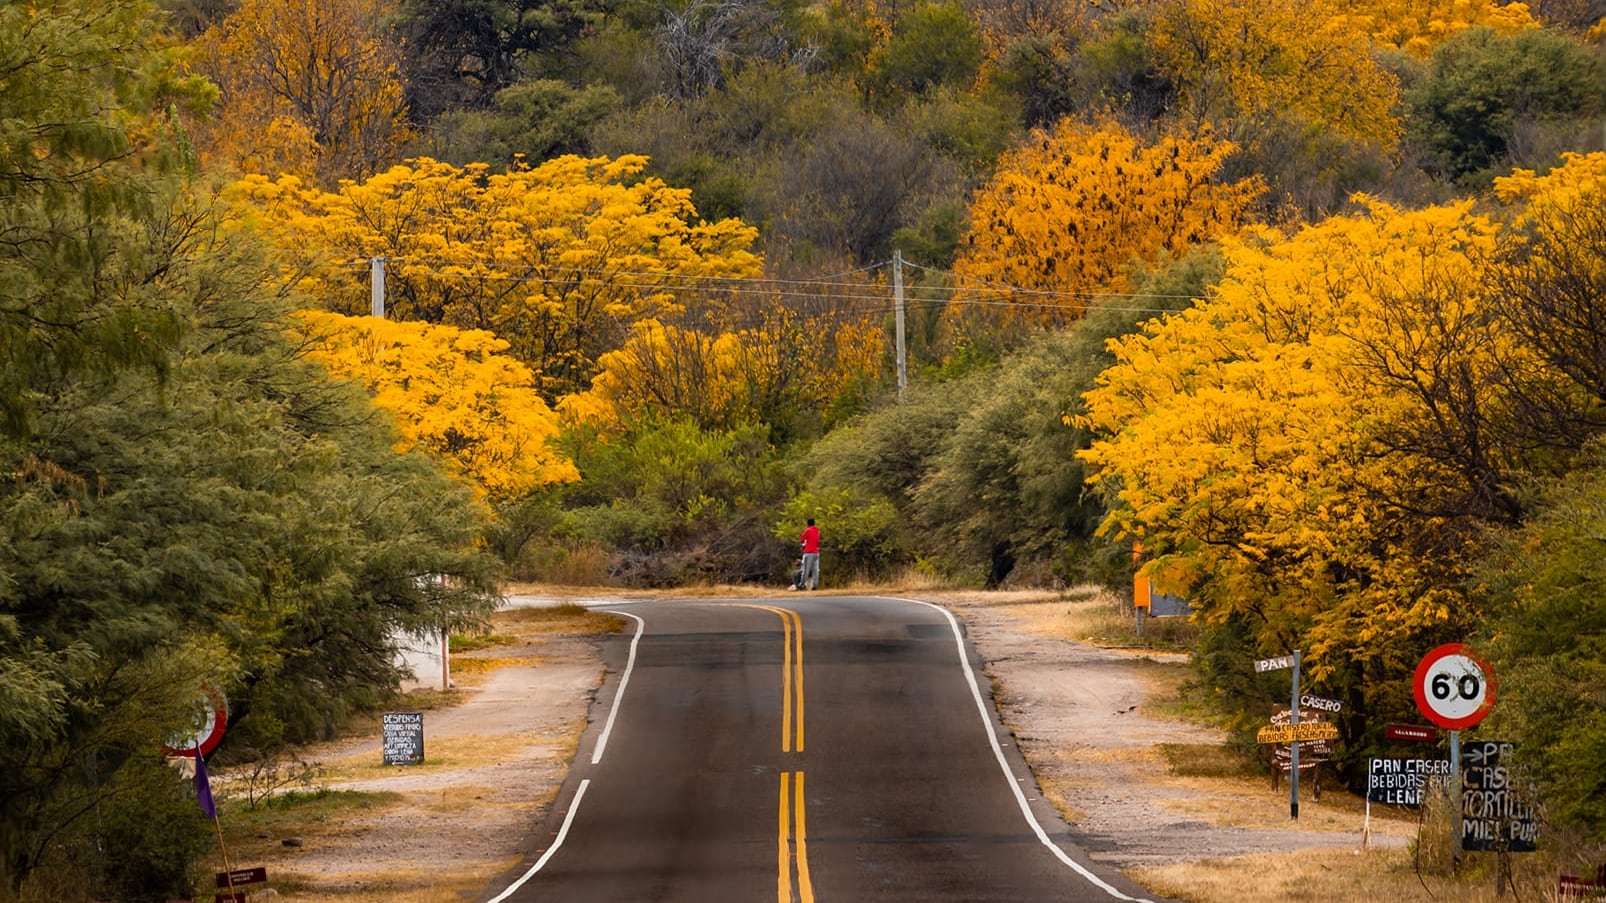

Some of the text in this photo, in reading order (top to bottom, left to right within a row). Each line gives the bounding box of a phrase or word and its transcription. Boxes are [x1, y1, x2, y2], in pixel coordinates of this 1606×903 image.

[1260, 658, 1288, 671] PAN
[1432, 673, 1480, 700] 60
[1300, 695, 1341, 713] CASERO
[383, 715, 421, 724] DESPENSA
[1372, 759, 1401, 774] PAN
[1371, 774, 1425, 788] BEBIDAS
